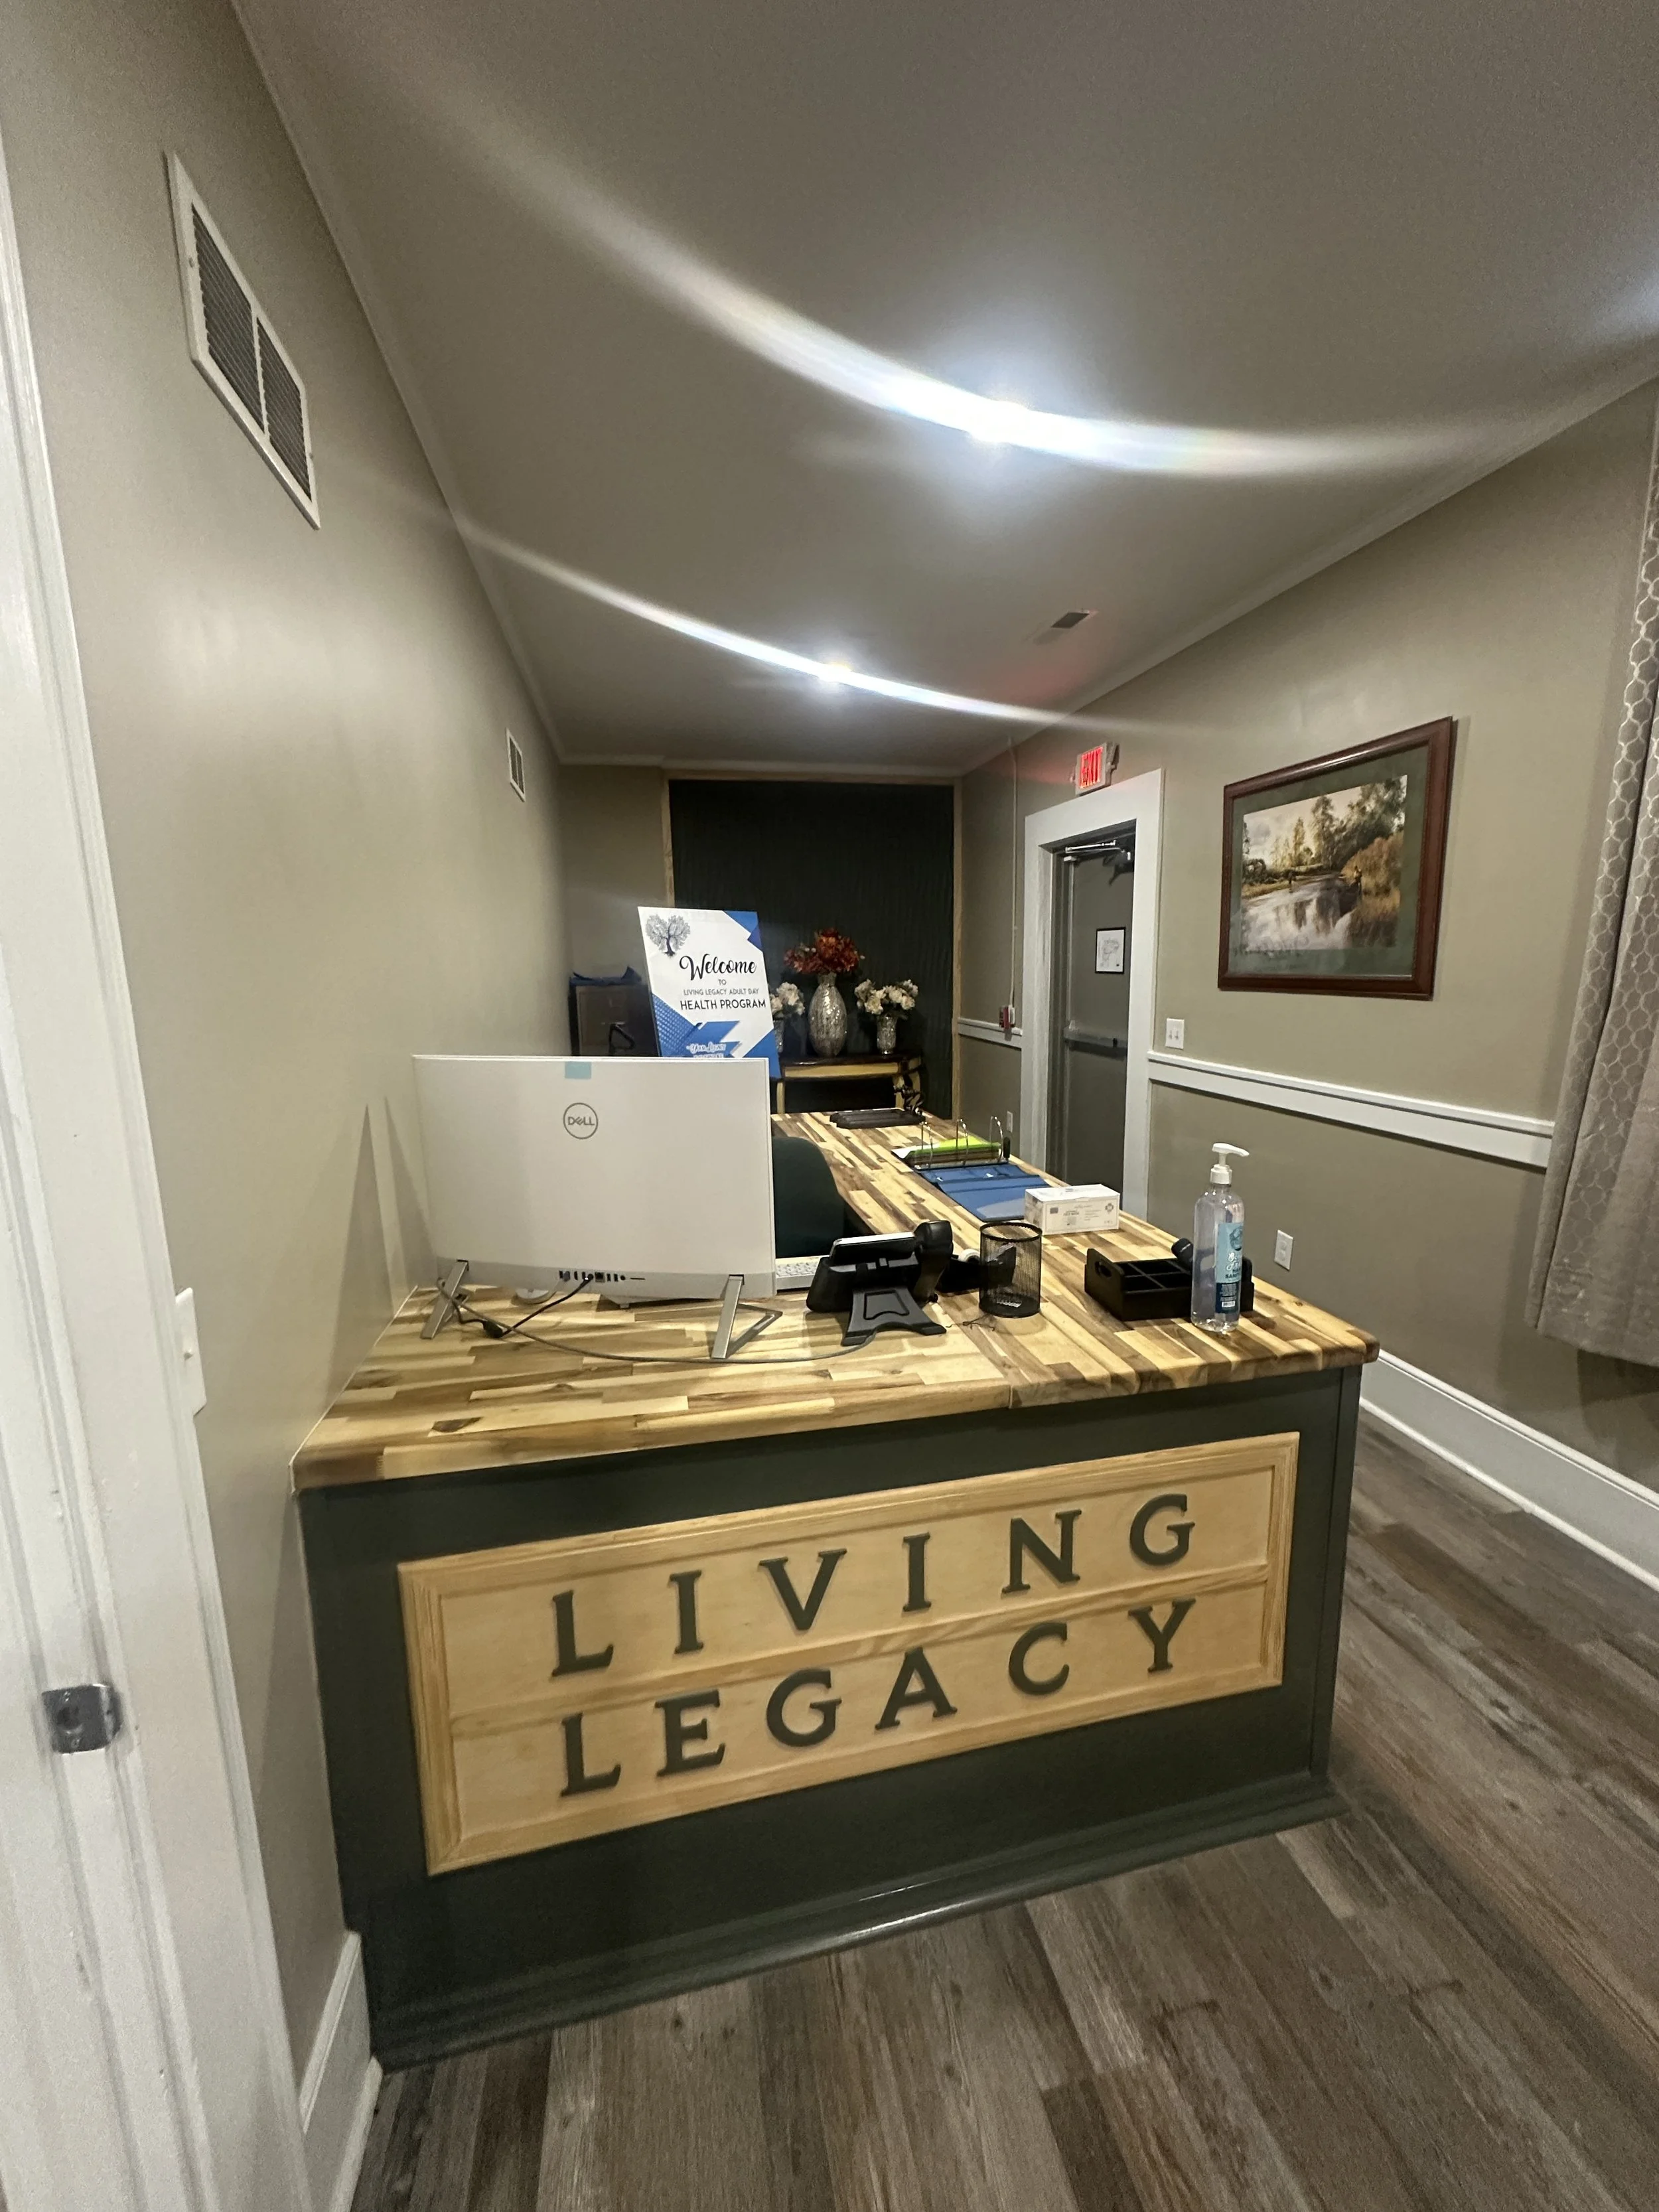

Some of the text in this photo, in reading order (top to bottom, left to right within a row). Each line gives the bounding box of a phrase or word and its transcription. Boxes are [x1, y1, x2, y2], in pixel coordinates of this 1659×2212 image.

[1080, 746, 1103, 789] EXIT
[679, 953, 757, 981] Welcome
[680, 999, 766, 1010] HEALTH PROGRAM
[567, 1116, 595, 1126] DELL
[551, 1493, 1196, 1678] LIVING
[559, 1598, 1196, 1797] LEGACY
